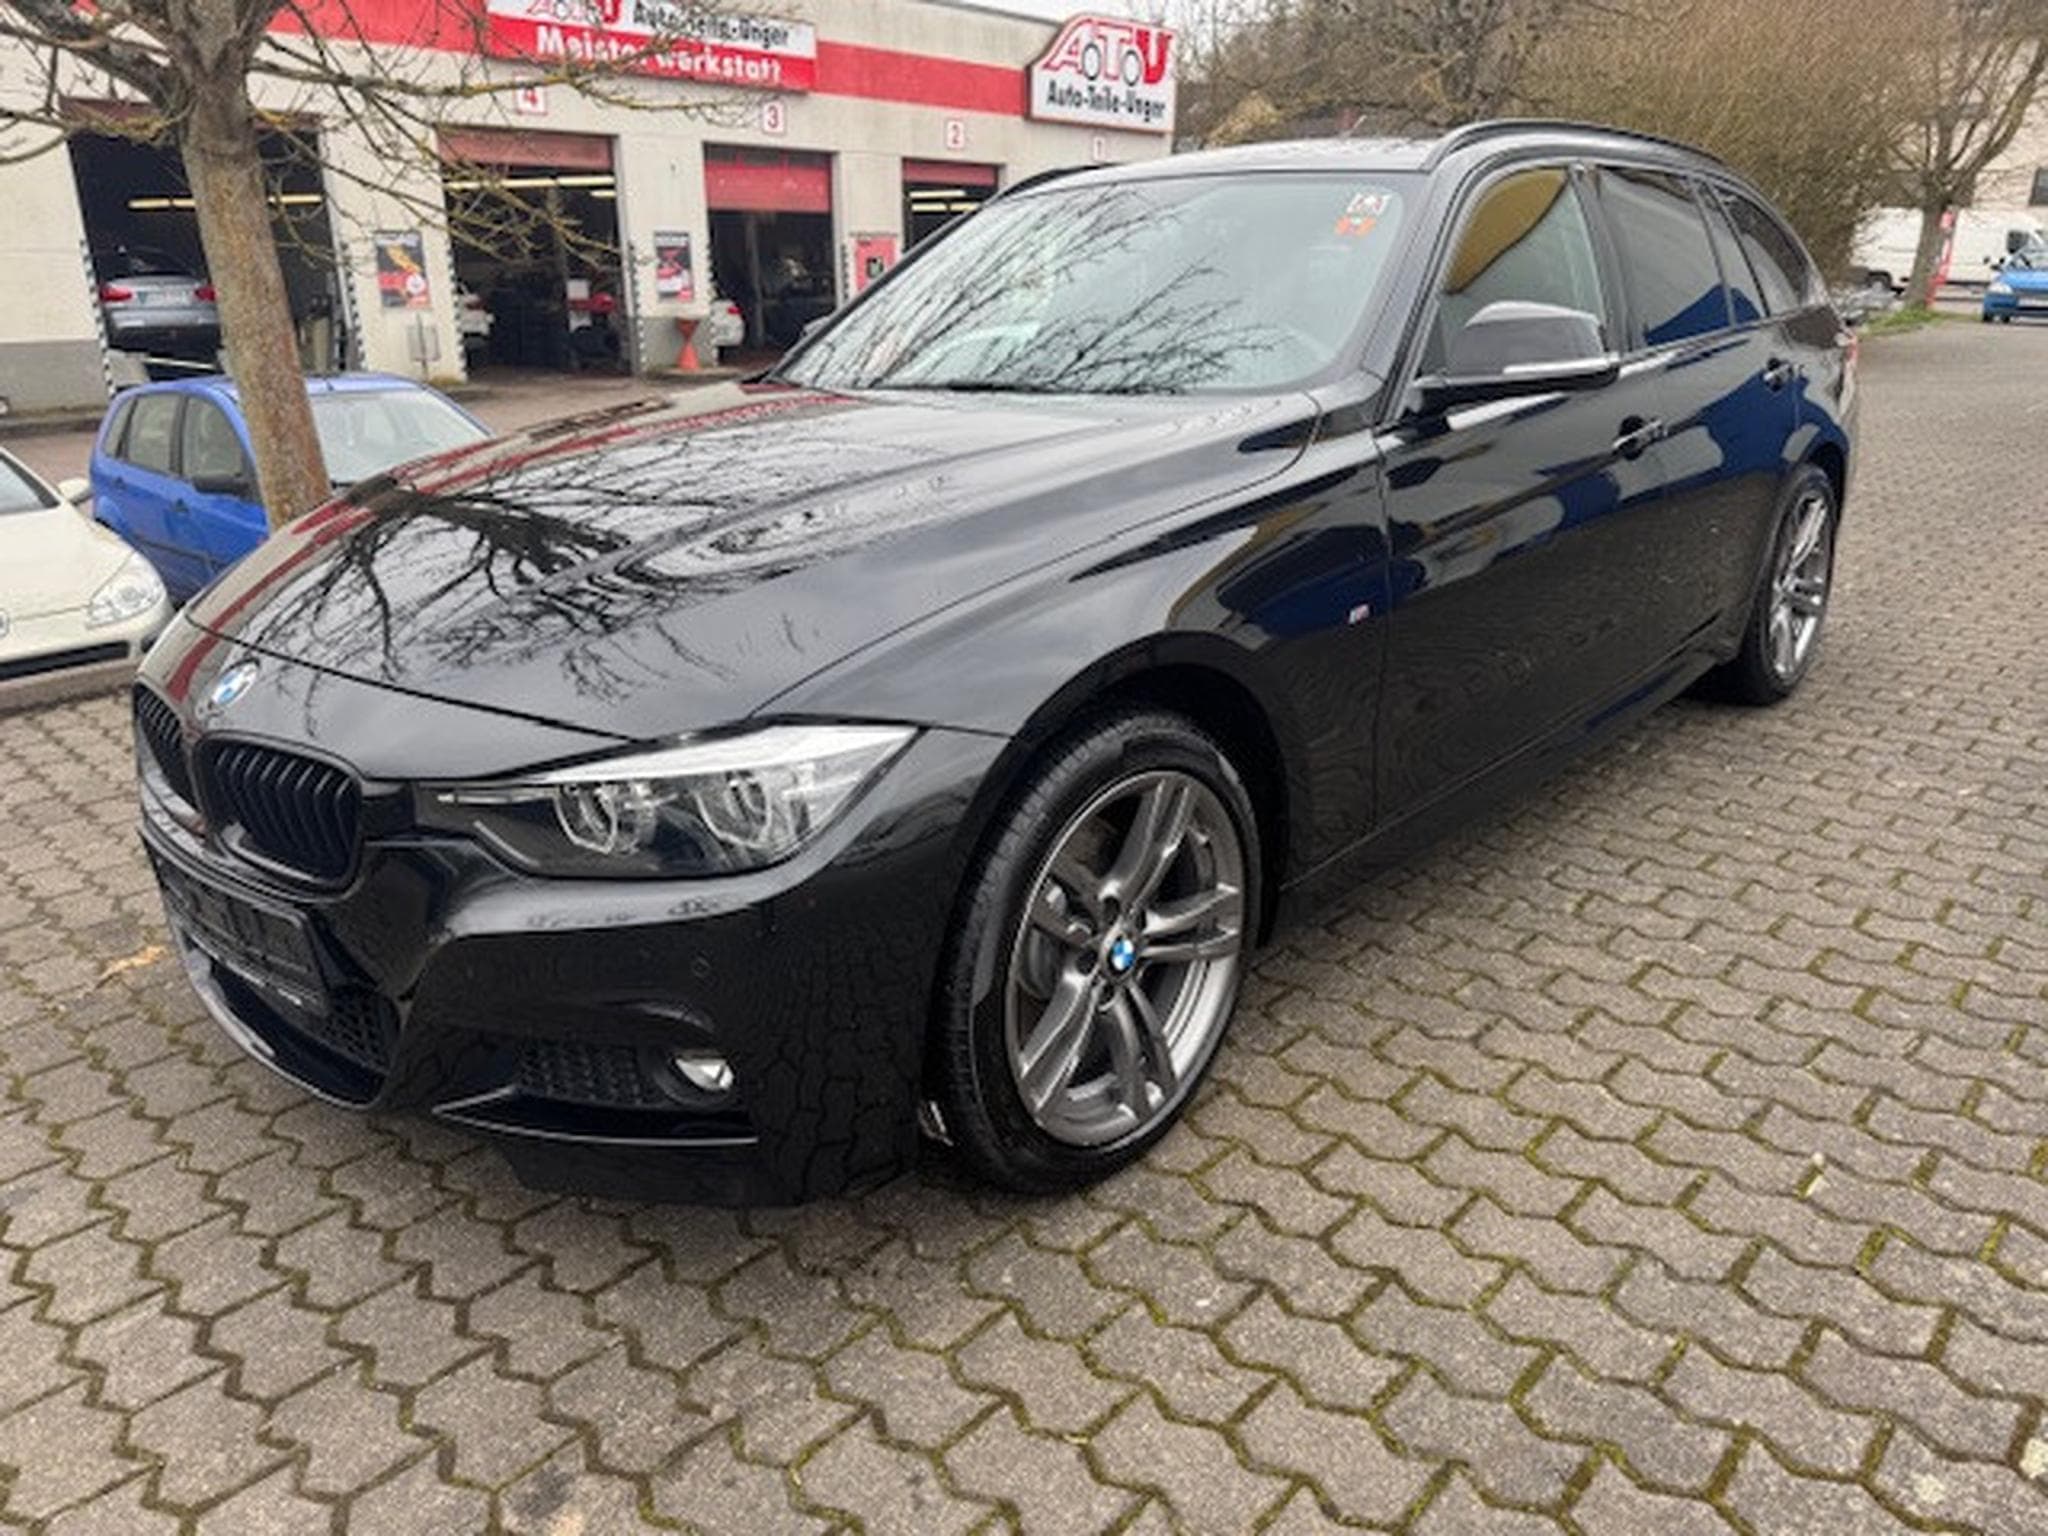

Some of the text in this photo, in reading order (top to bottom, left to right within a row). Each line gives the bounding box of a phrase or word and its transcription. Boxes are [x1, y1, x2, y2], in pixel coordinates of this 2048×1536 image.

[633, 0, 789, 49] Autoeile-Unger
[767, 105, 779, 129] 3
[951, 123, 961, 145] 2
